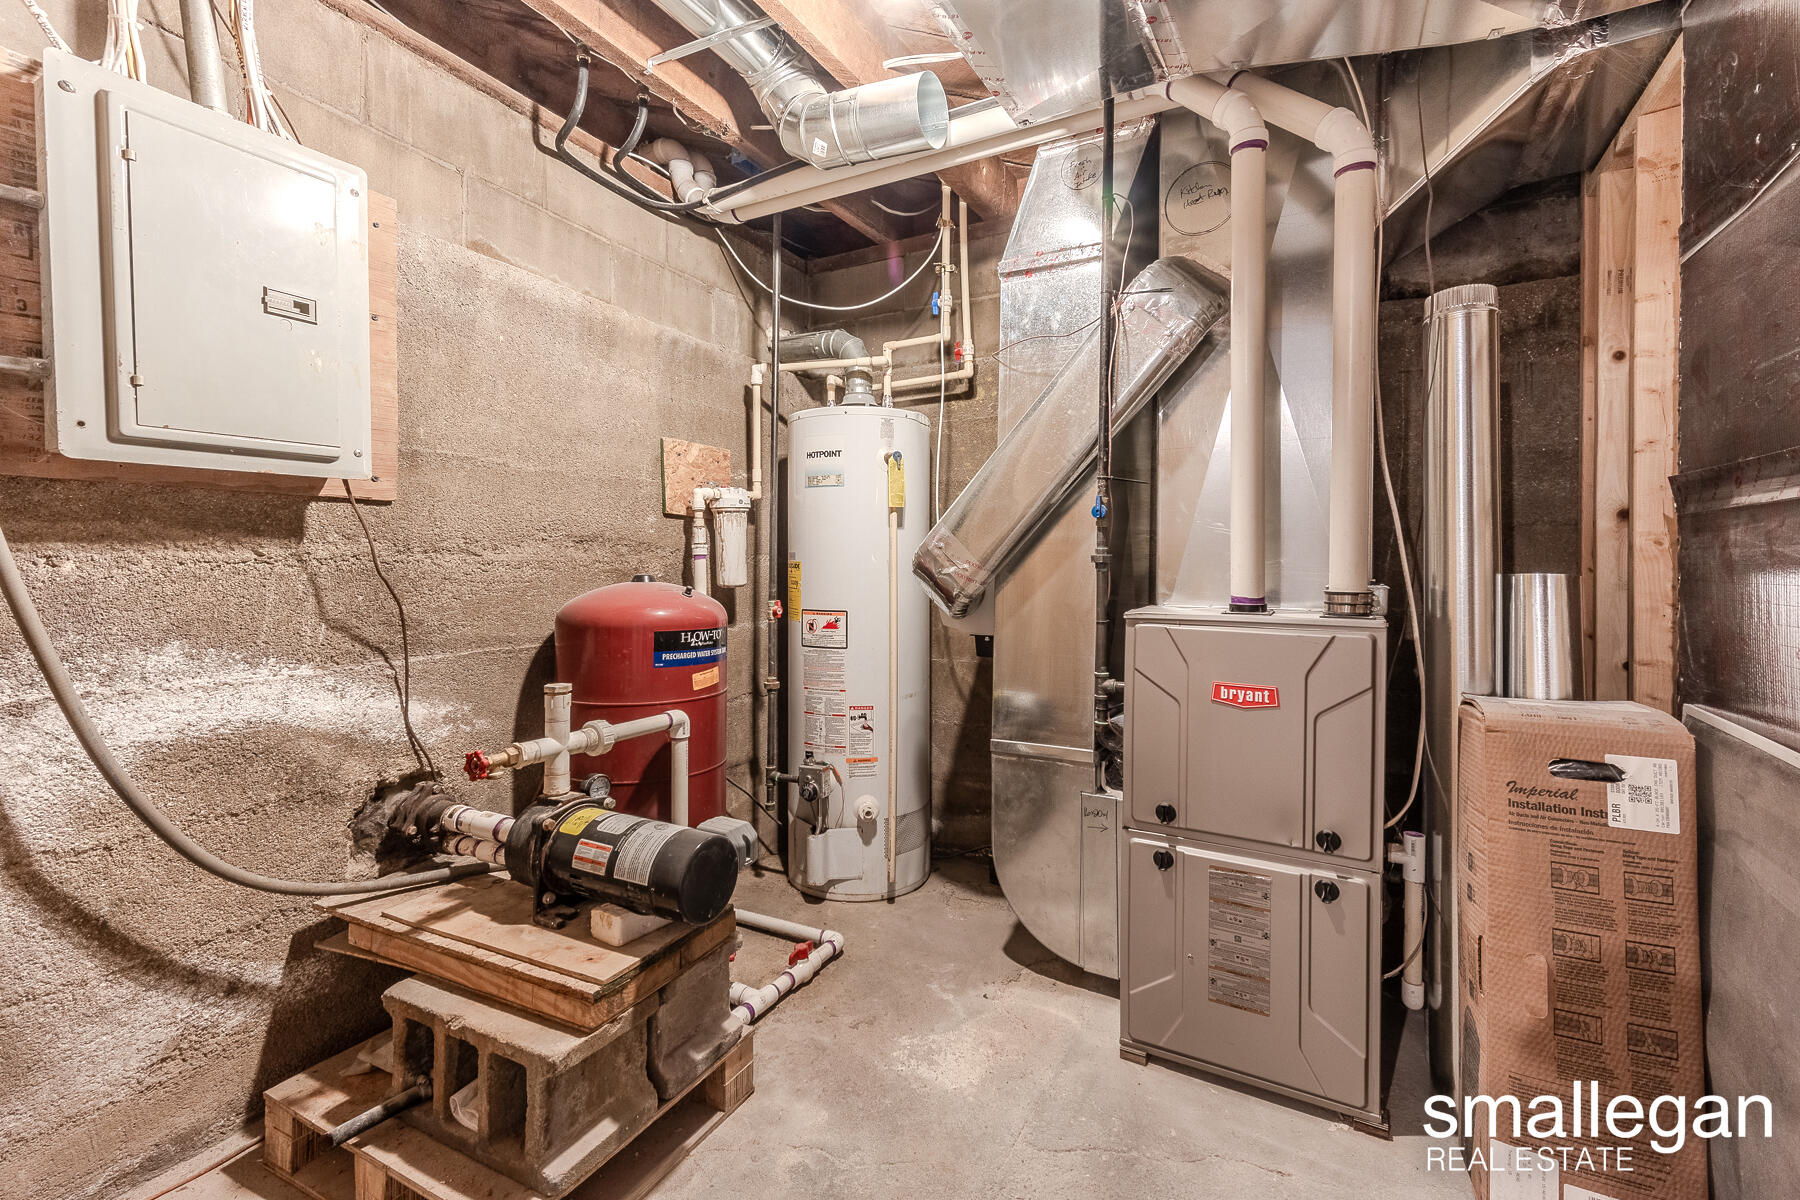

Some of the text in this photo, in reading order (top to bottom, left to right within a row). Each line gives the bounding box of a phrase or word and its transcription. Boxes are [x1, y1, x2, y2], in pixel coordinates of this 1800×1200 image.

[806, 450, 842, 459] HOTPOINT
[662, 651, 697, 661] PRECHARGED
[697, 650, 710, 658] WATER
[1220, 686, 1270, 704] bryant
[1506, 780, 1579, 799] Imperial
[1507, 798, 1577, 816] Installation
